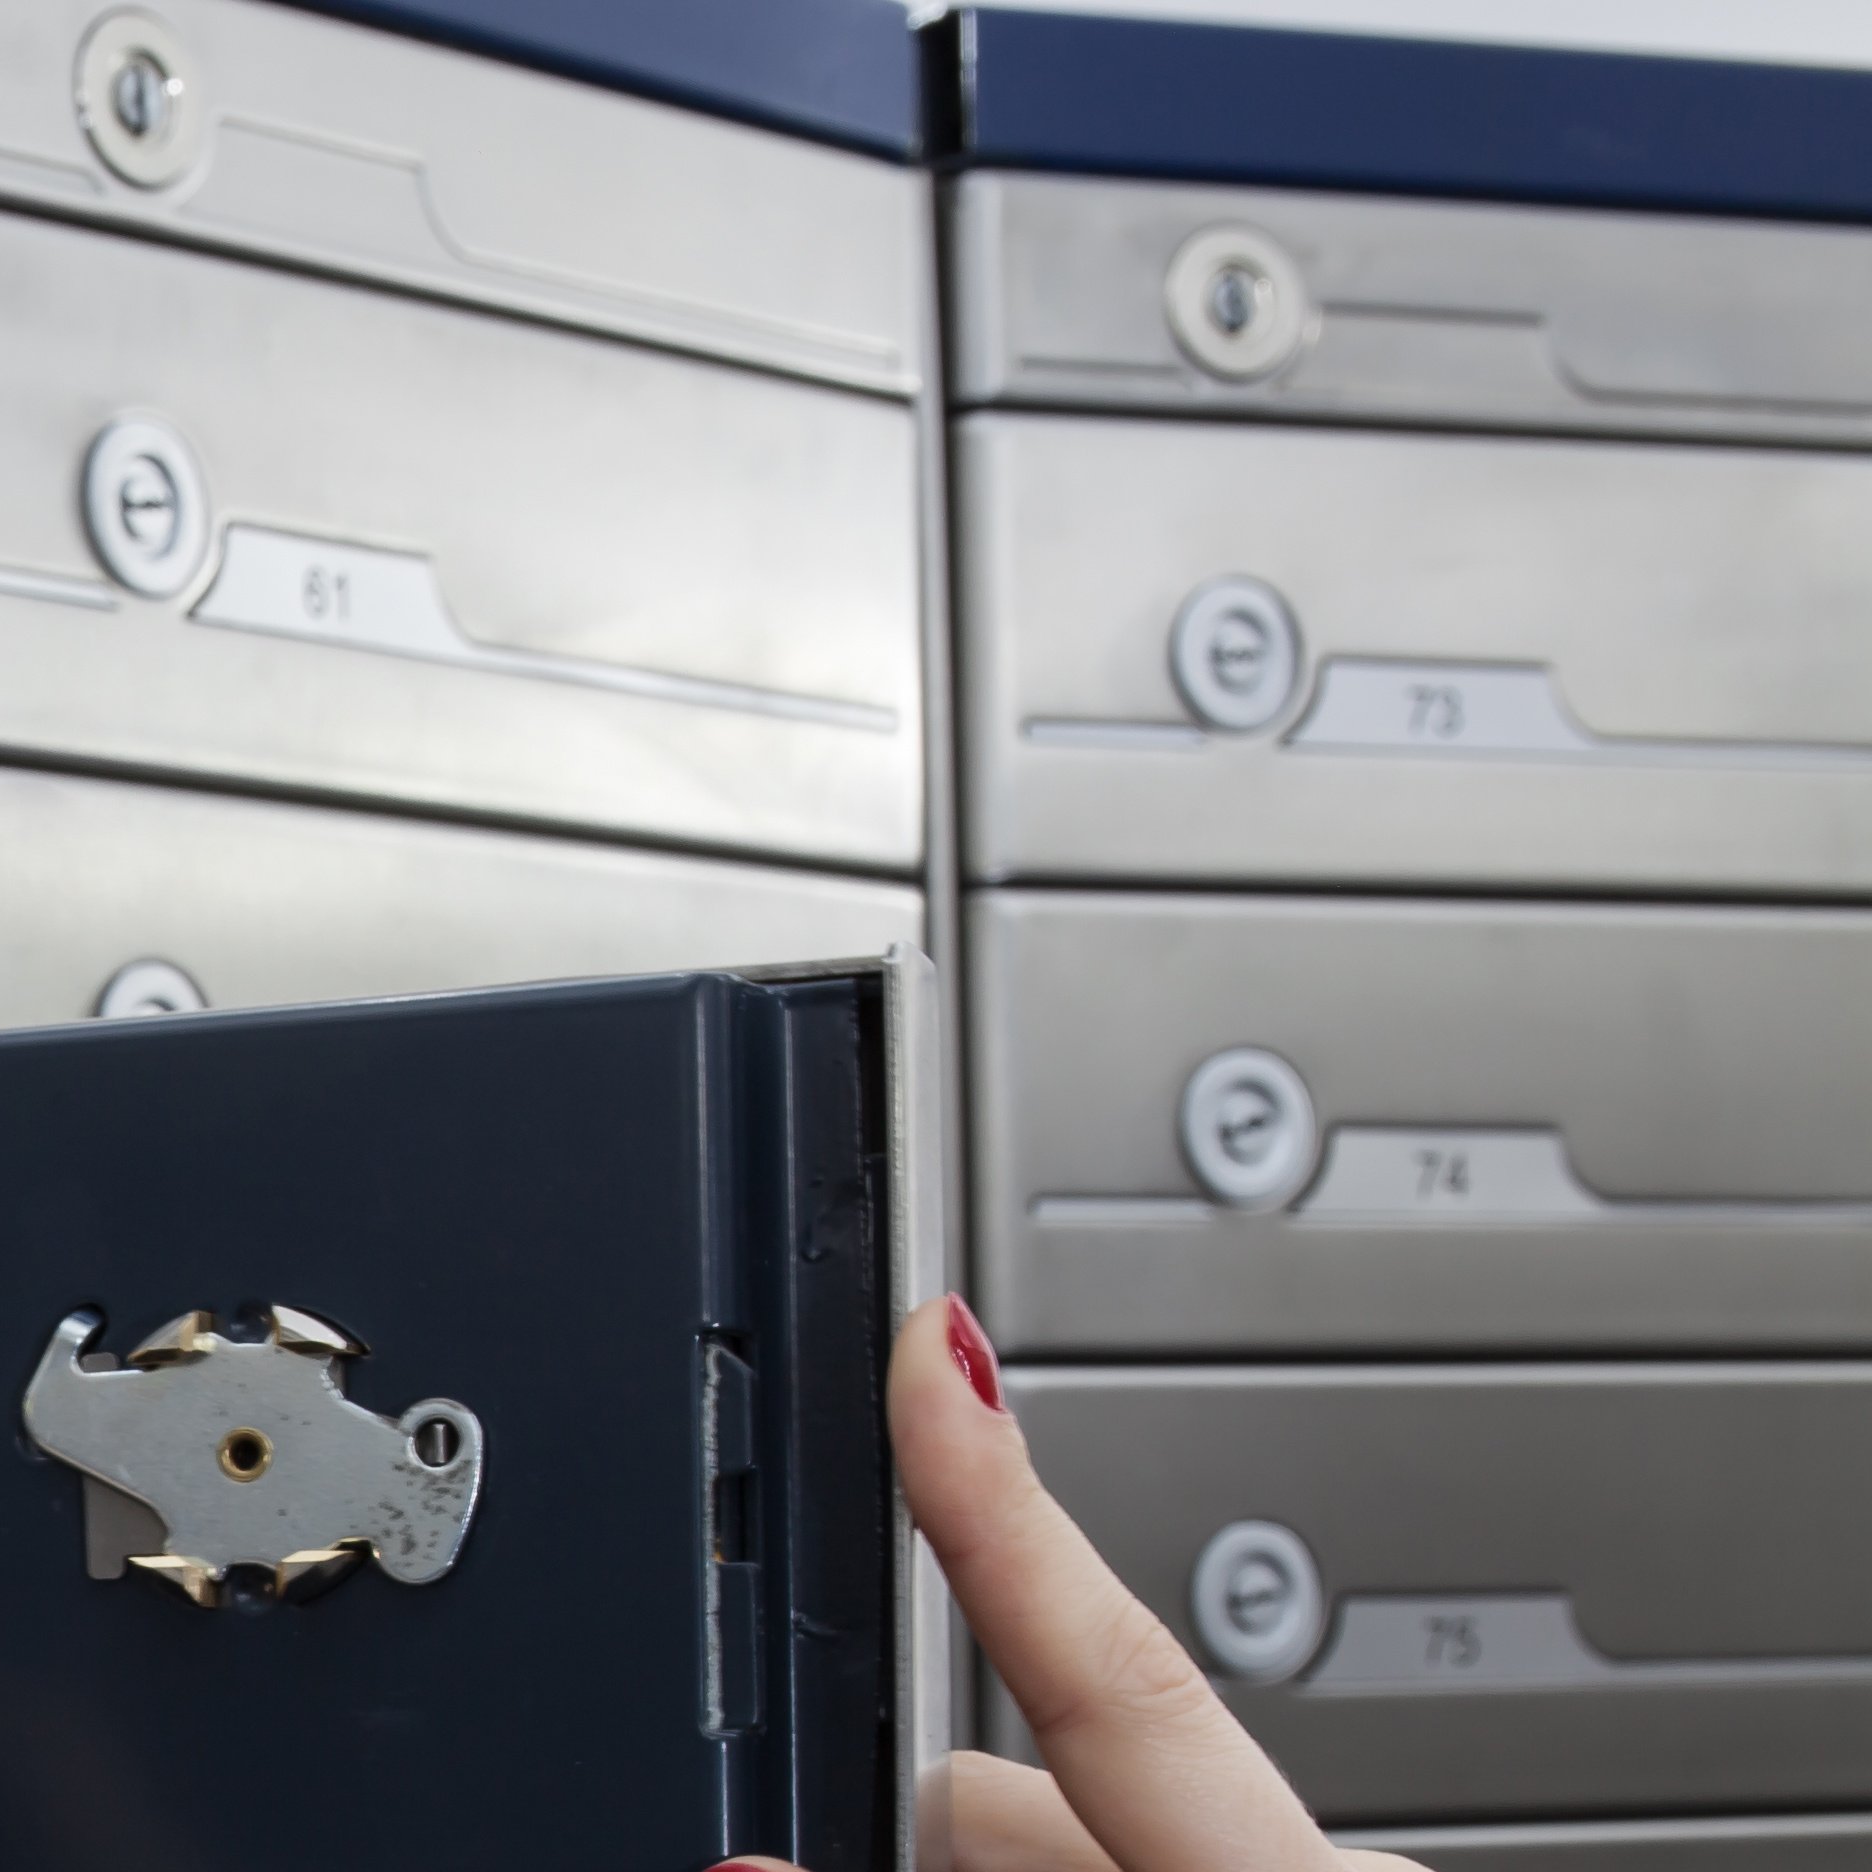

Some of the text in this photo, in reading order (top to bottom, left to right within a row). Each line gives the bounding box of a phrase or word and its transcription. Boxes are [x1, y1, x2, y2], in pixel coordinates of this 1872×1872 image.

[304, 569, 353, 623] 61
[1404, 684, 1465, 738] 73
[1413, 1150, 1470, 1201] 74
